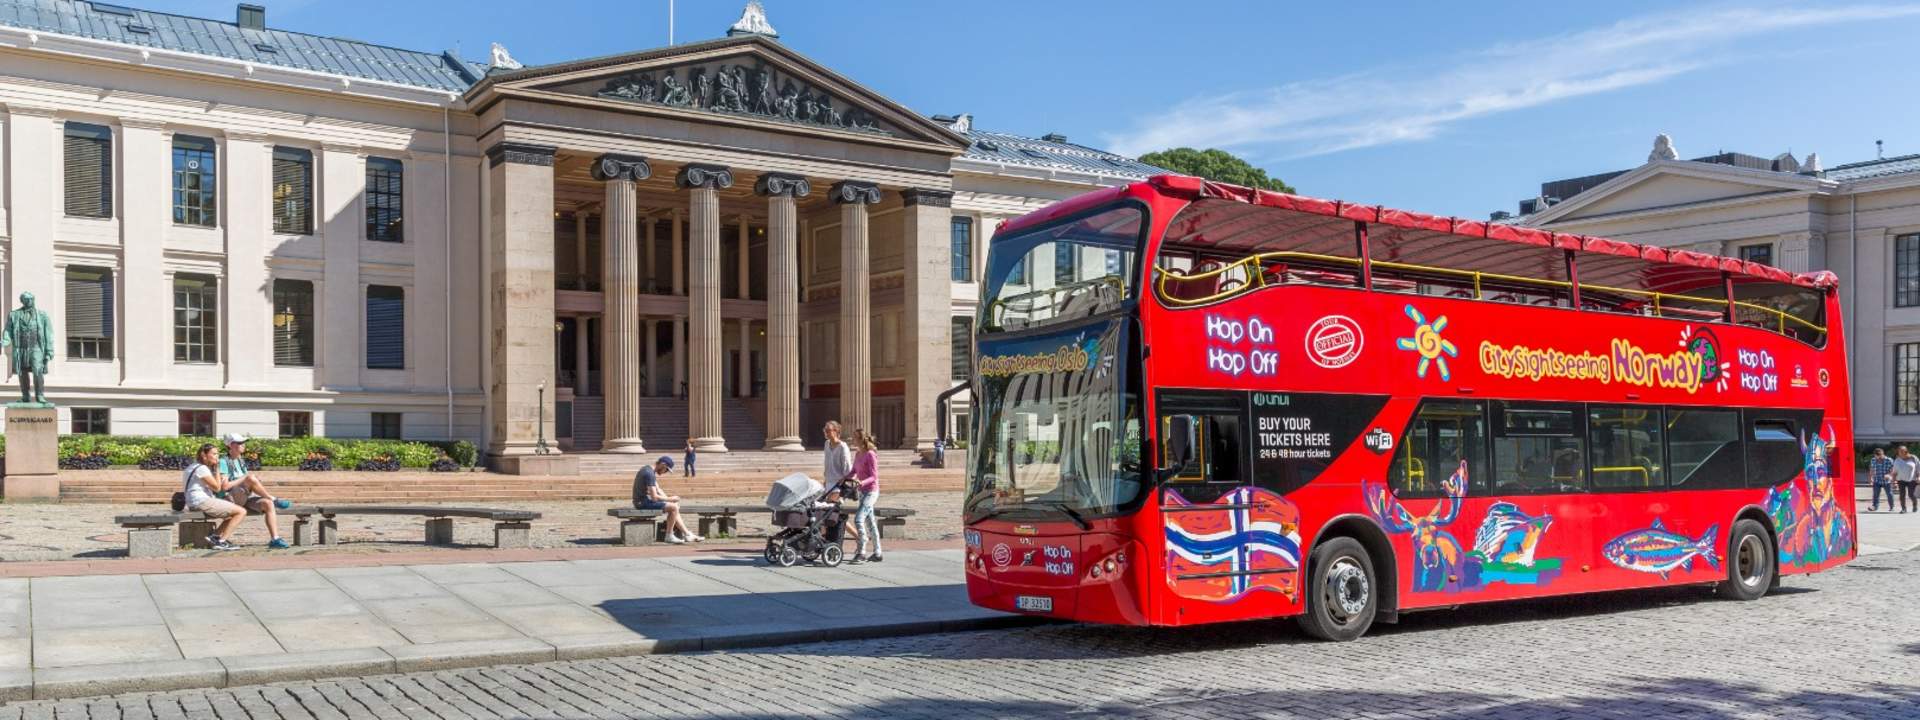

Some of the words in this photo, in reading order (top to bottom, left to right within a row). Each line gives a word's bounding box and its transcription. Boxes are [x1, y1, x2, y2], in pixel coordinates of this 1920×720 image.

[1206, 315, 1243, 343] Hop
[1249, 318, 1273, 343] On
[1315, 332, 1353, 351] OFFICIAL
[1056, 345, 1088, 372] Oslo
[1207, 348, 1245, 375] Hop
[1250, 350, 1277, 374] Off
[1480, 340, 1610, 384] CitySightseeing
[1738, 349, 1760, 368] Hop
[1760, 350, 1775, 368] On
[1741, 372, 1761, 392] Hop
[1762, 373, 1777, 391] Off
[1259, 417, 1280, 430] BUY
[1282, 418, 1311, 431] YOUR
[1259, 433, 1302, 446] TICKETS
[1304, 433, 1331, 446] HERE
[1278, 449, 1288, 458] 48
[1289, 448, 1305, 458] hour
[1306, 449, 1331, 458] tickets
[1043, 546, 1059, 559] Hop
[1060, 546, 1071, 558] On
[1045, 562, 1060, 574] Hop
[1061, 562, 1074, 574] Off
